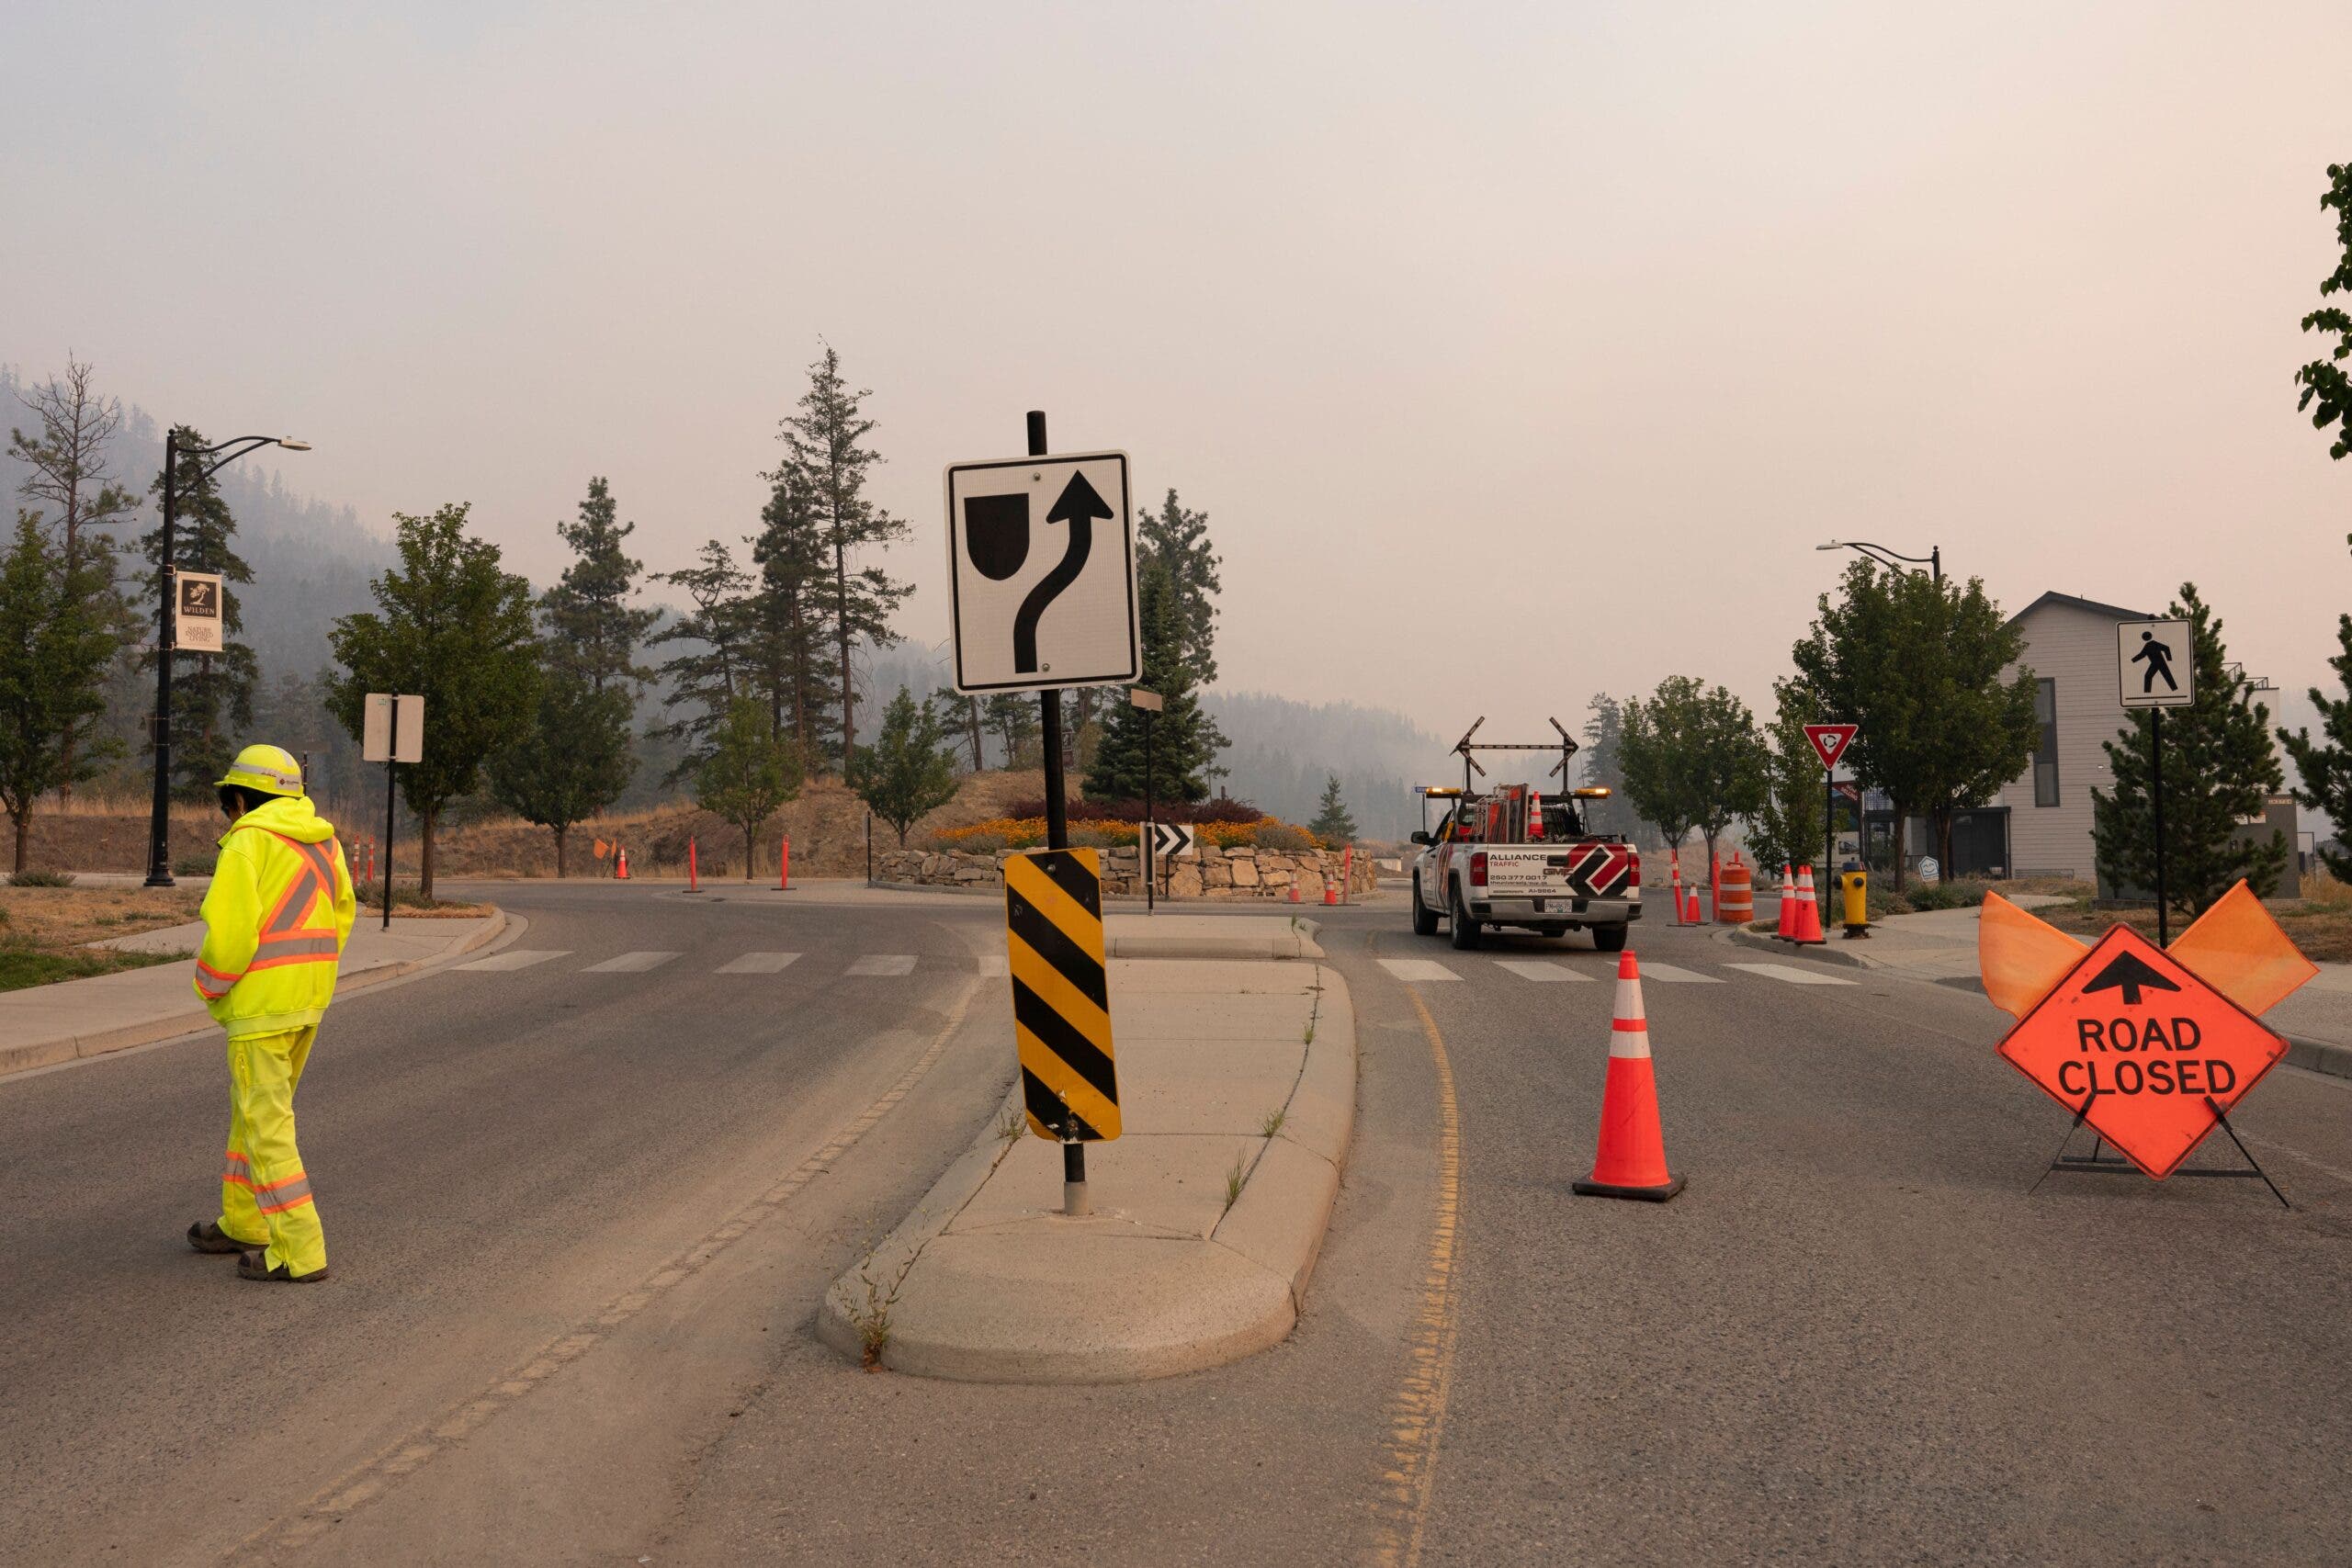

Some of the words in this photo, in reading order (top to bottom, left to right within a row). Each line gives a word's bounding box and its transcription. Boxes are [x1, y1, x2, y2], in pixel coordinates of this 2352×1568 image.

[184, 606, 215, 615] WILDEN
[1543, 868, 1574, 877] GMC
[2076, 1017, 2202, 1053] ROAD
[2057, 1059, 2237, 1096] CLOSED
